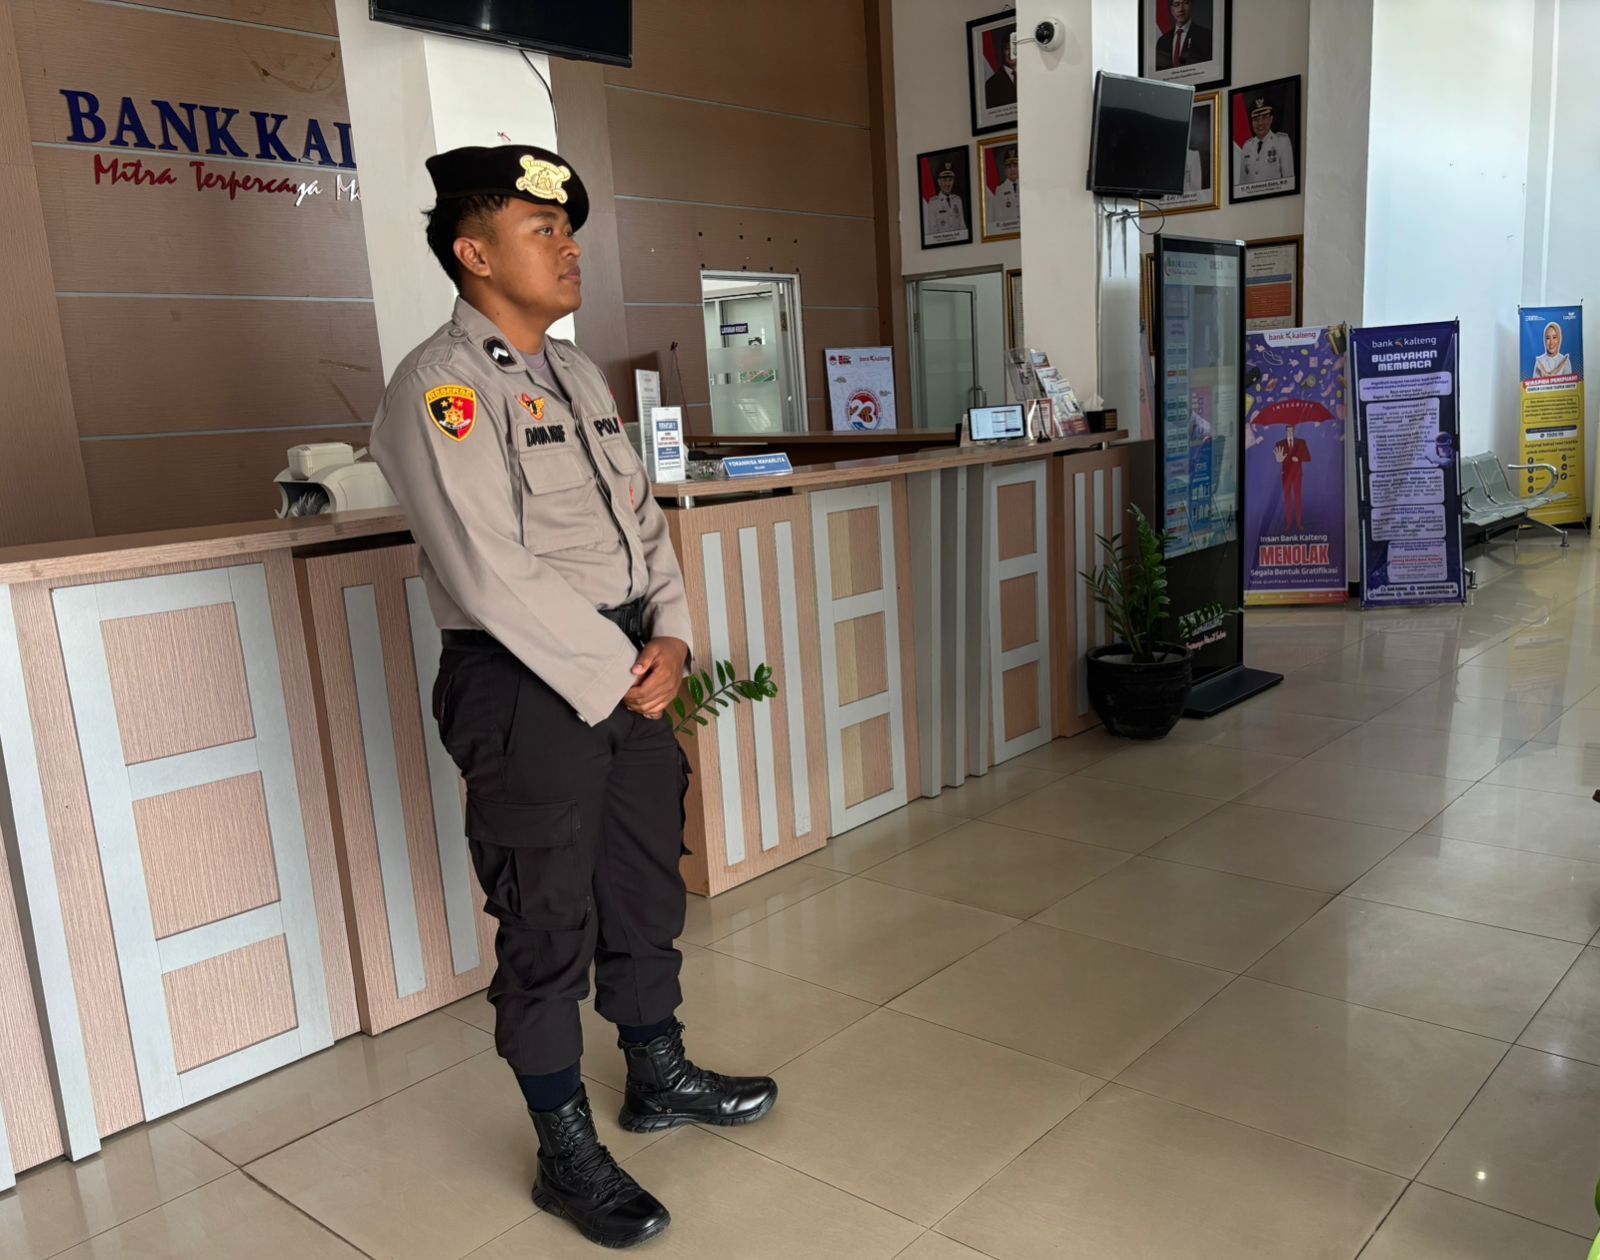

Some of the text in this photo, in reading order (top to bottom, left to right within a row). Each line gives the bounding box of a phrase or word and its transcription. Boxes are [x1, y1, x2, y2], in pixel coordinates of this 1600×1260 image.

[59, 89, 249, 158] BANK
[94, 154, 177, 185] Mitra
[189, 161, 323, 207] Terpercaya
[1372, 336, 1437, 348] bank kalteng
[1371, 350, 1438, 363] BUDAYAKAN
[1377, 360, 1432, 372] MEMBACA
[1281, 534, 1299, 542] Bank
[1300, 534, 1328, 542] Kalteng
[1260, 544, 1329, 566] MENOLAK
[1251, 566, 1338, 577] Segala Bentuk Gratifikasi
